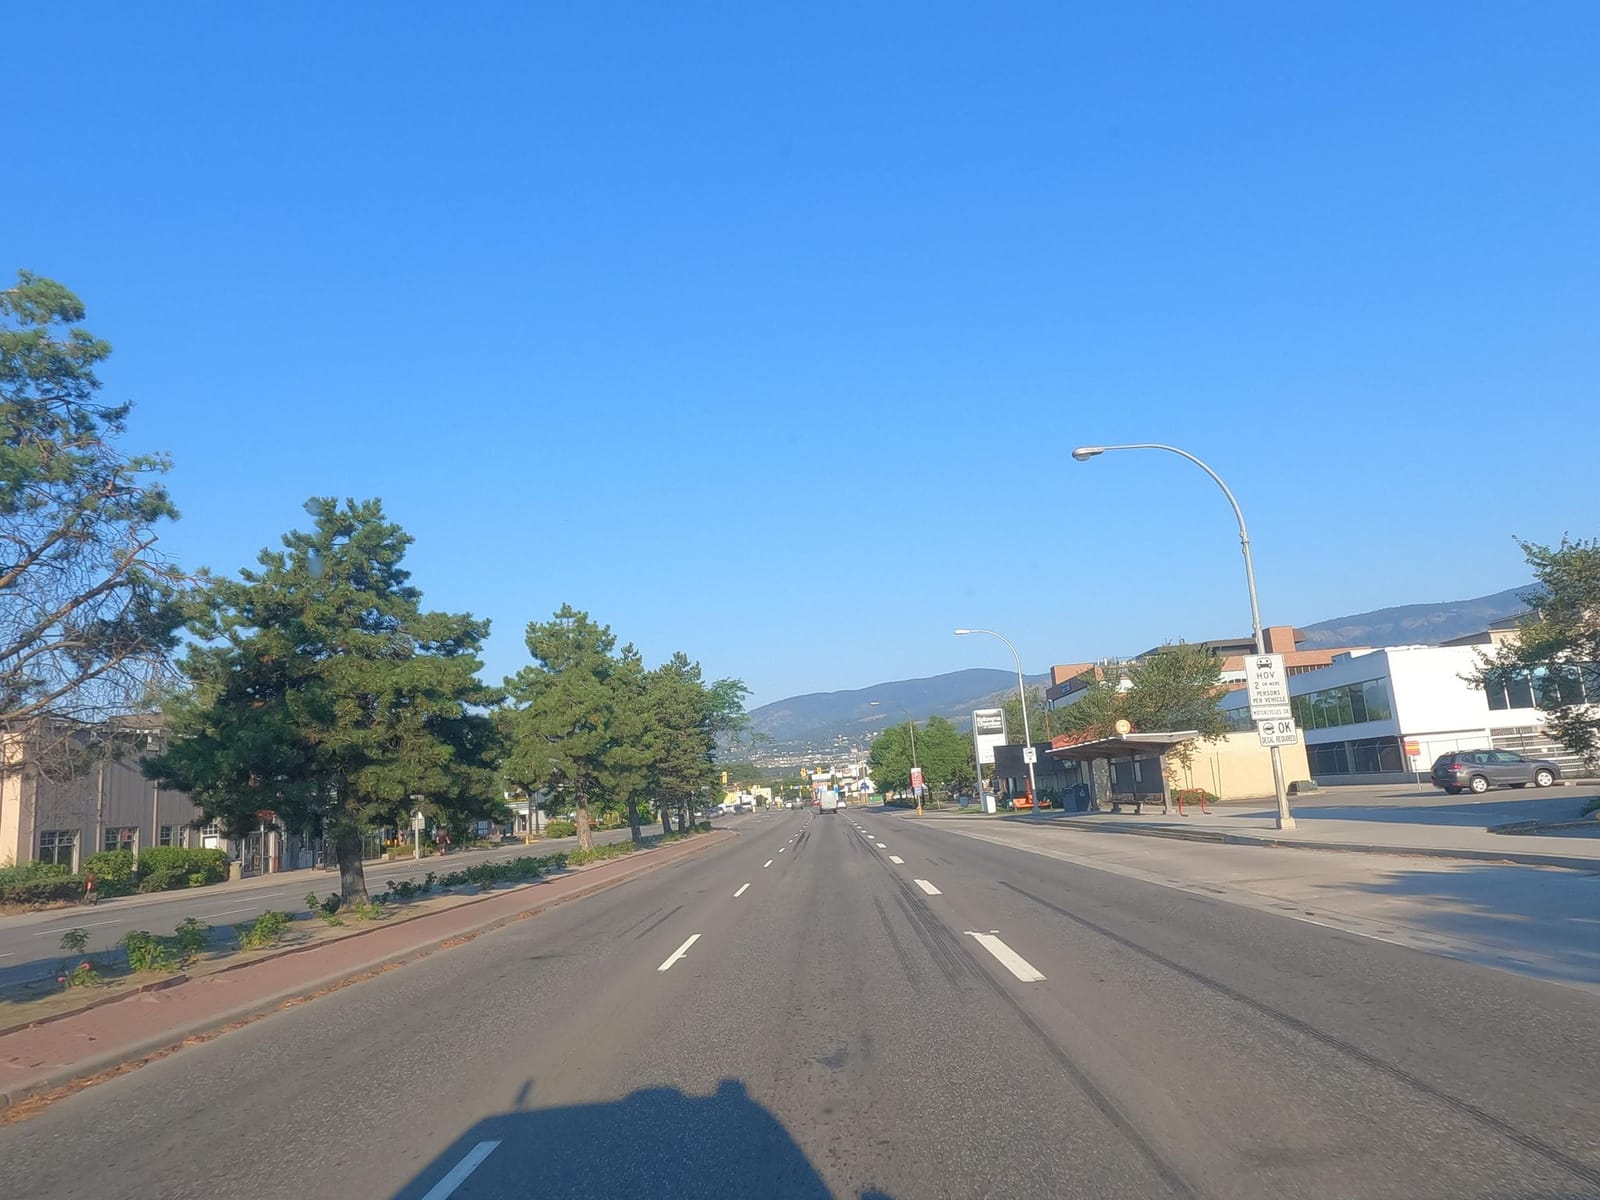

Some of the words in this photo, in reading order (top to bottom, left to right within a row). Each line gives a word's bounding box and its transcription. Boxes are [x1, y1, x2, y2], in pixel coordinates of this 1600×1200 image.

[1256, 671, 1275, 680] HOV
[1254, 681, 1260, 690] 2
[1278, 721, 1292, 734] OK
